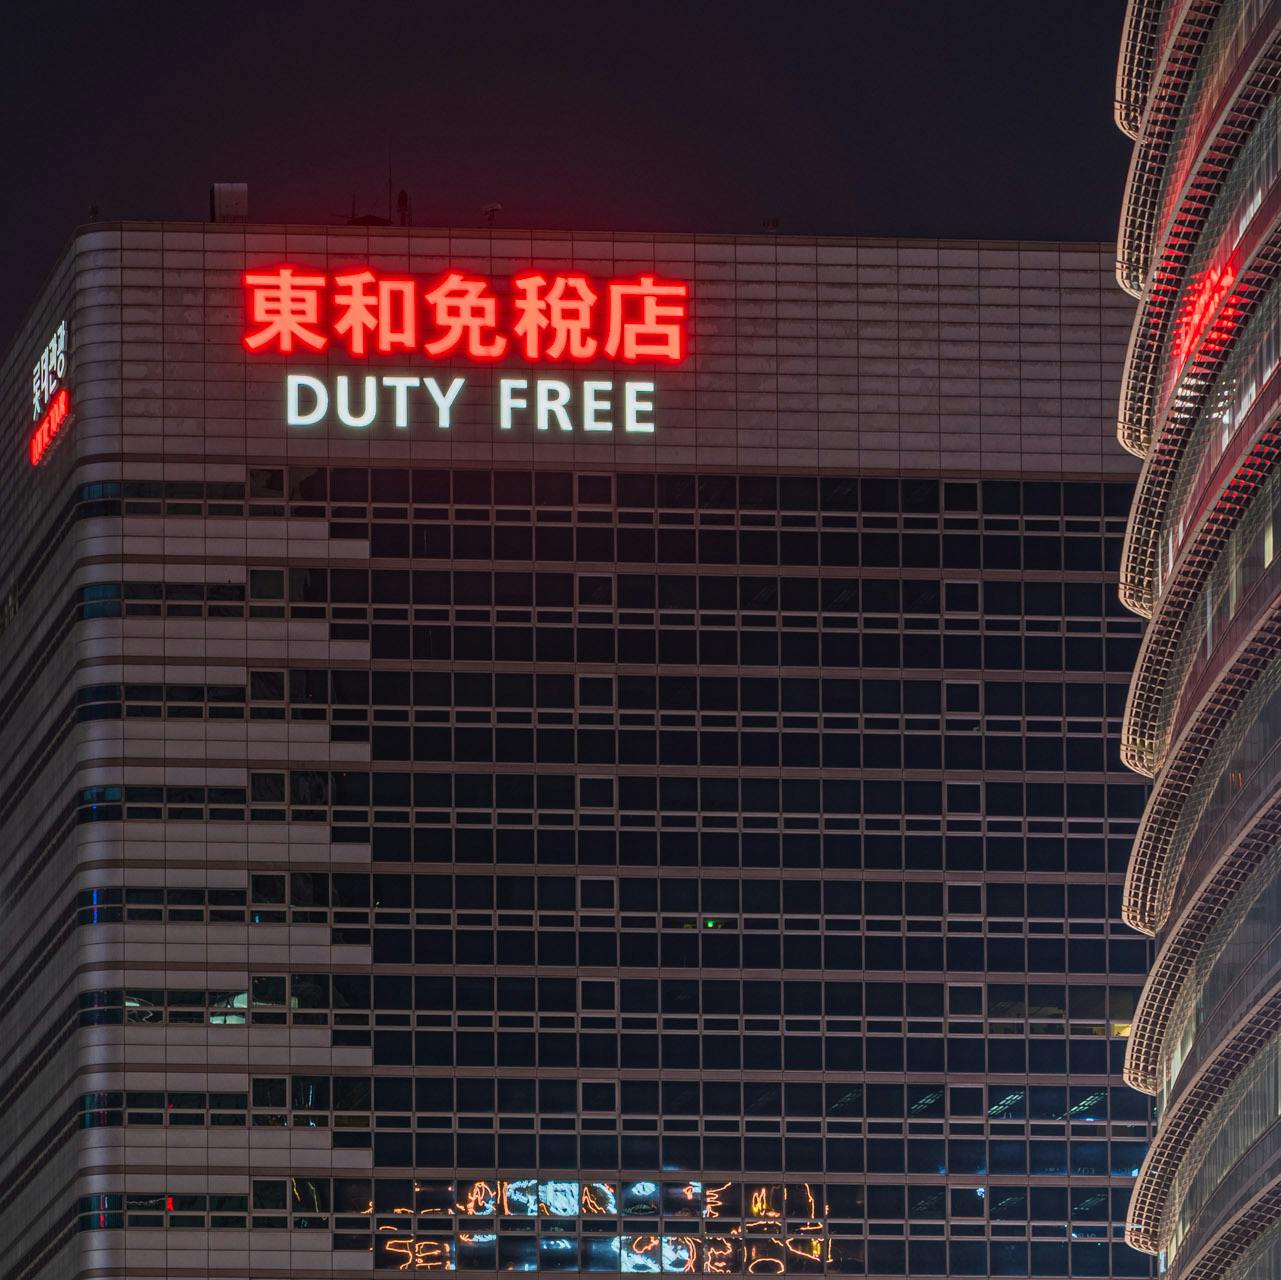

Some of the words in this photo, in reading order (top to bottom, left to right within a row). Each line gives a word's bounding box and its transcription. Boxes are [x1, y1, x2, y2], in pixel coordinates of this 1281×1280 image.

[243, 267, 688, 361] 東和免稅店
[285, 374, 466, 430] DUTY
[499, 378, 656, 433] FREE
